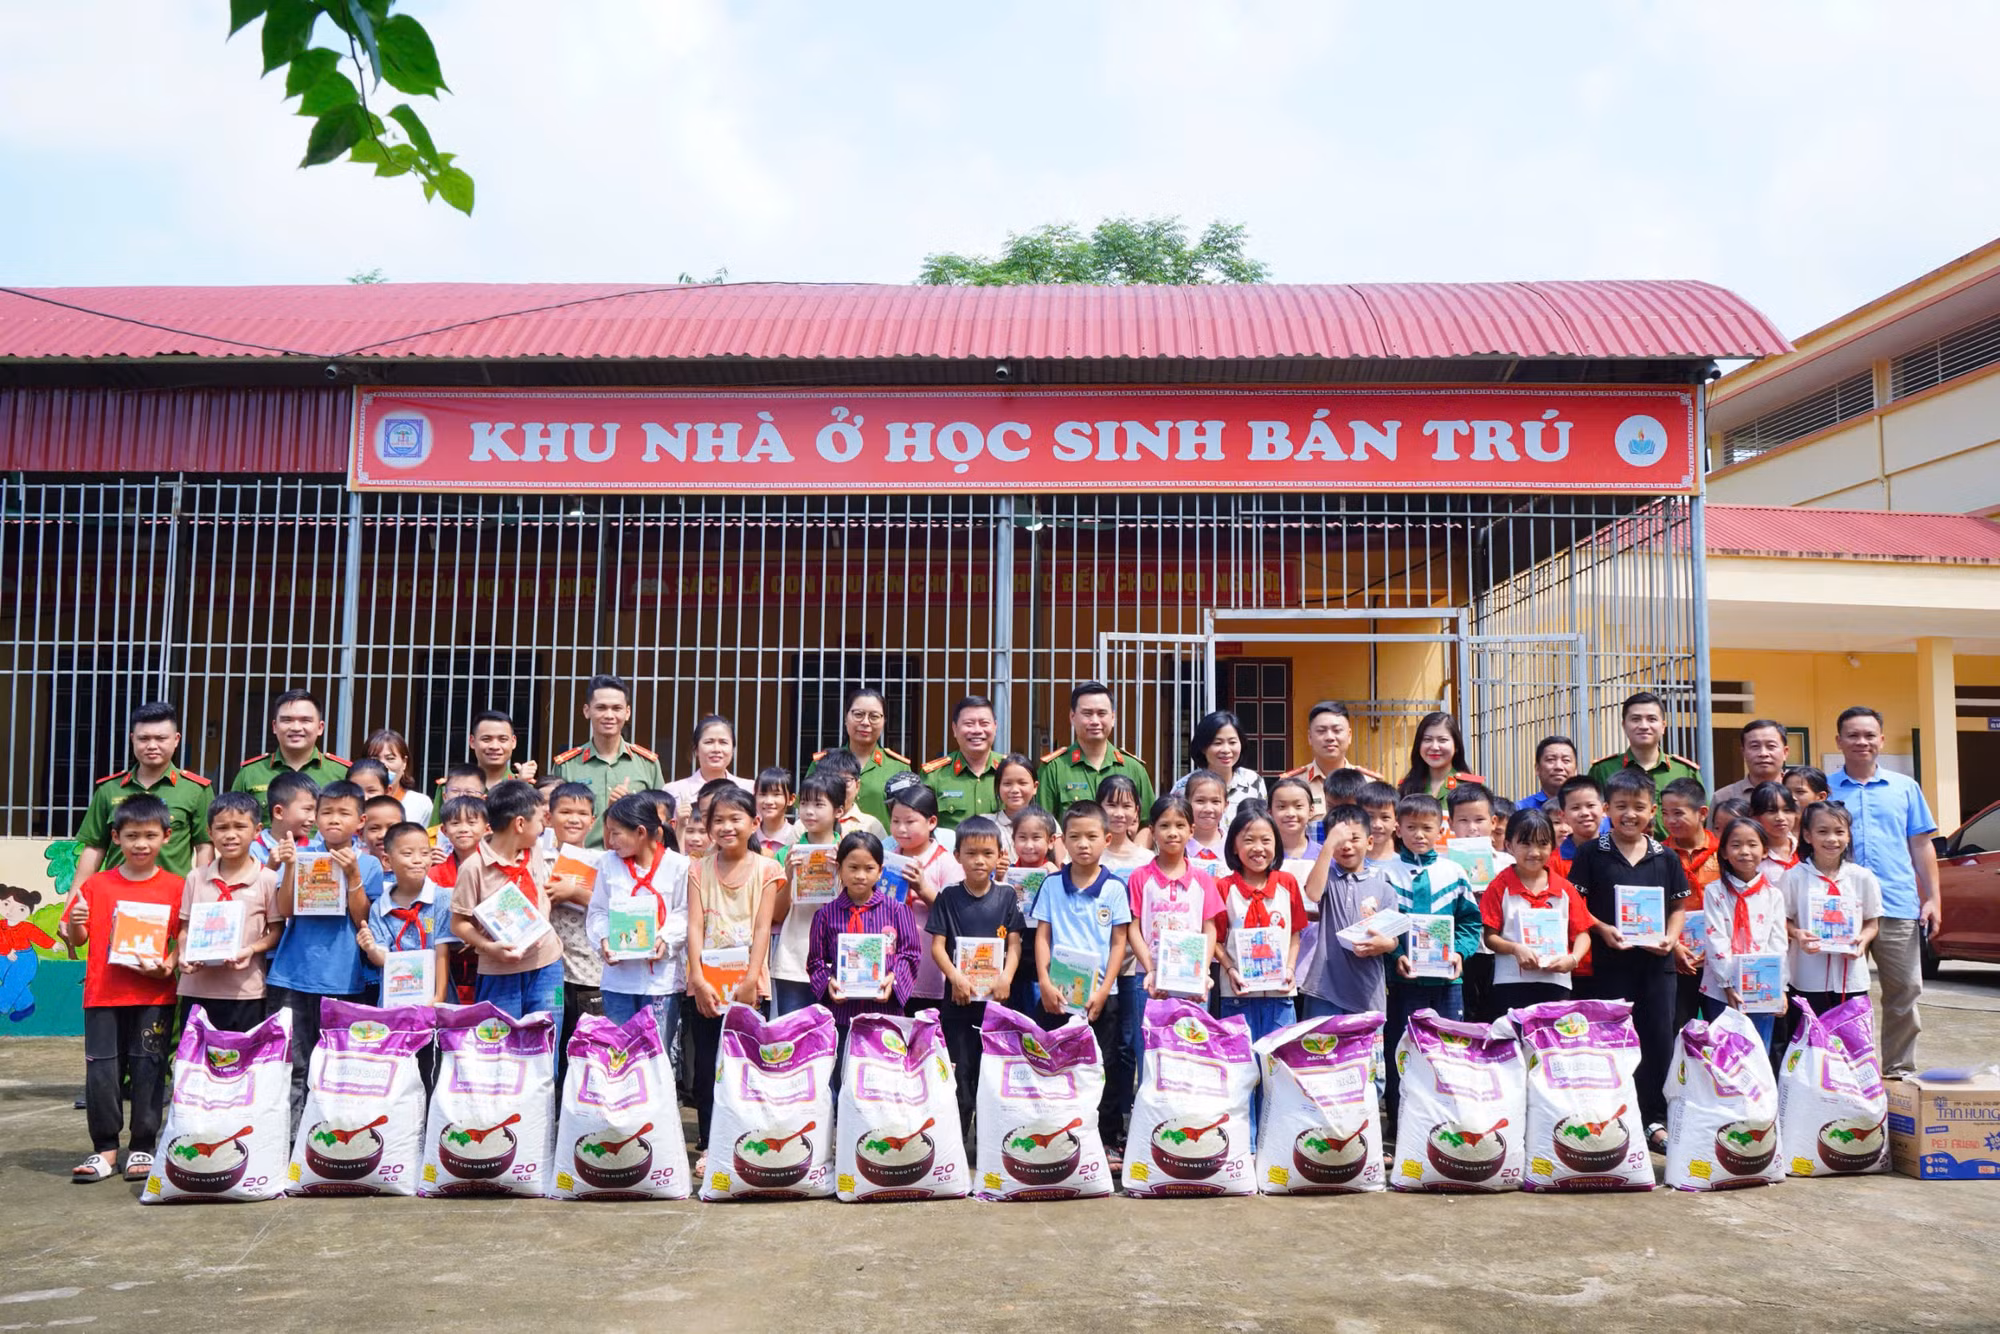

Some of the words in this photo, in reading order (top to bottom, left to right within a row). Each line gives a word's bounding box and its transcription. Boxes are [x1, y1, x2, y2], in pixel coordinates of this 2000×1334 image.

[468, 422, 620, 463] KHU
[640, 411, 796, 464] NHÀ
[816, 407, 864, 464] Ở
[884, 420, 1031, 476] HỌC
[1052, 420, 1226, 462] SINH
[1248, 409, 1402, 462] BÁN
[1422, 409, 1574, 462] TRÚ
[1627, 1151, 1645, 1164] 20
[378, 1163, 404, 1175] 20
[511, 1162, 537, 1175] 20
[932, 1162, 955, 1177] 20
[1078, 1161, 1100, 1175] 20
[1225, 1159, 1244, 1172] 20
[650, 1167, 674, 1181] 20
[808, 1165, 827, 1181] 20
[937, 1175, 951, 1183] KG
[1083, 1174, 1097, 1182] KG
[1229, 1171, 1242, 1179] KG
[1500, 1167, 1520, 1178] 20
[242, 1175, 268, 1187] 20
